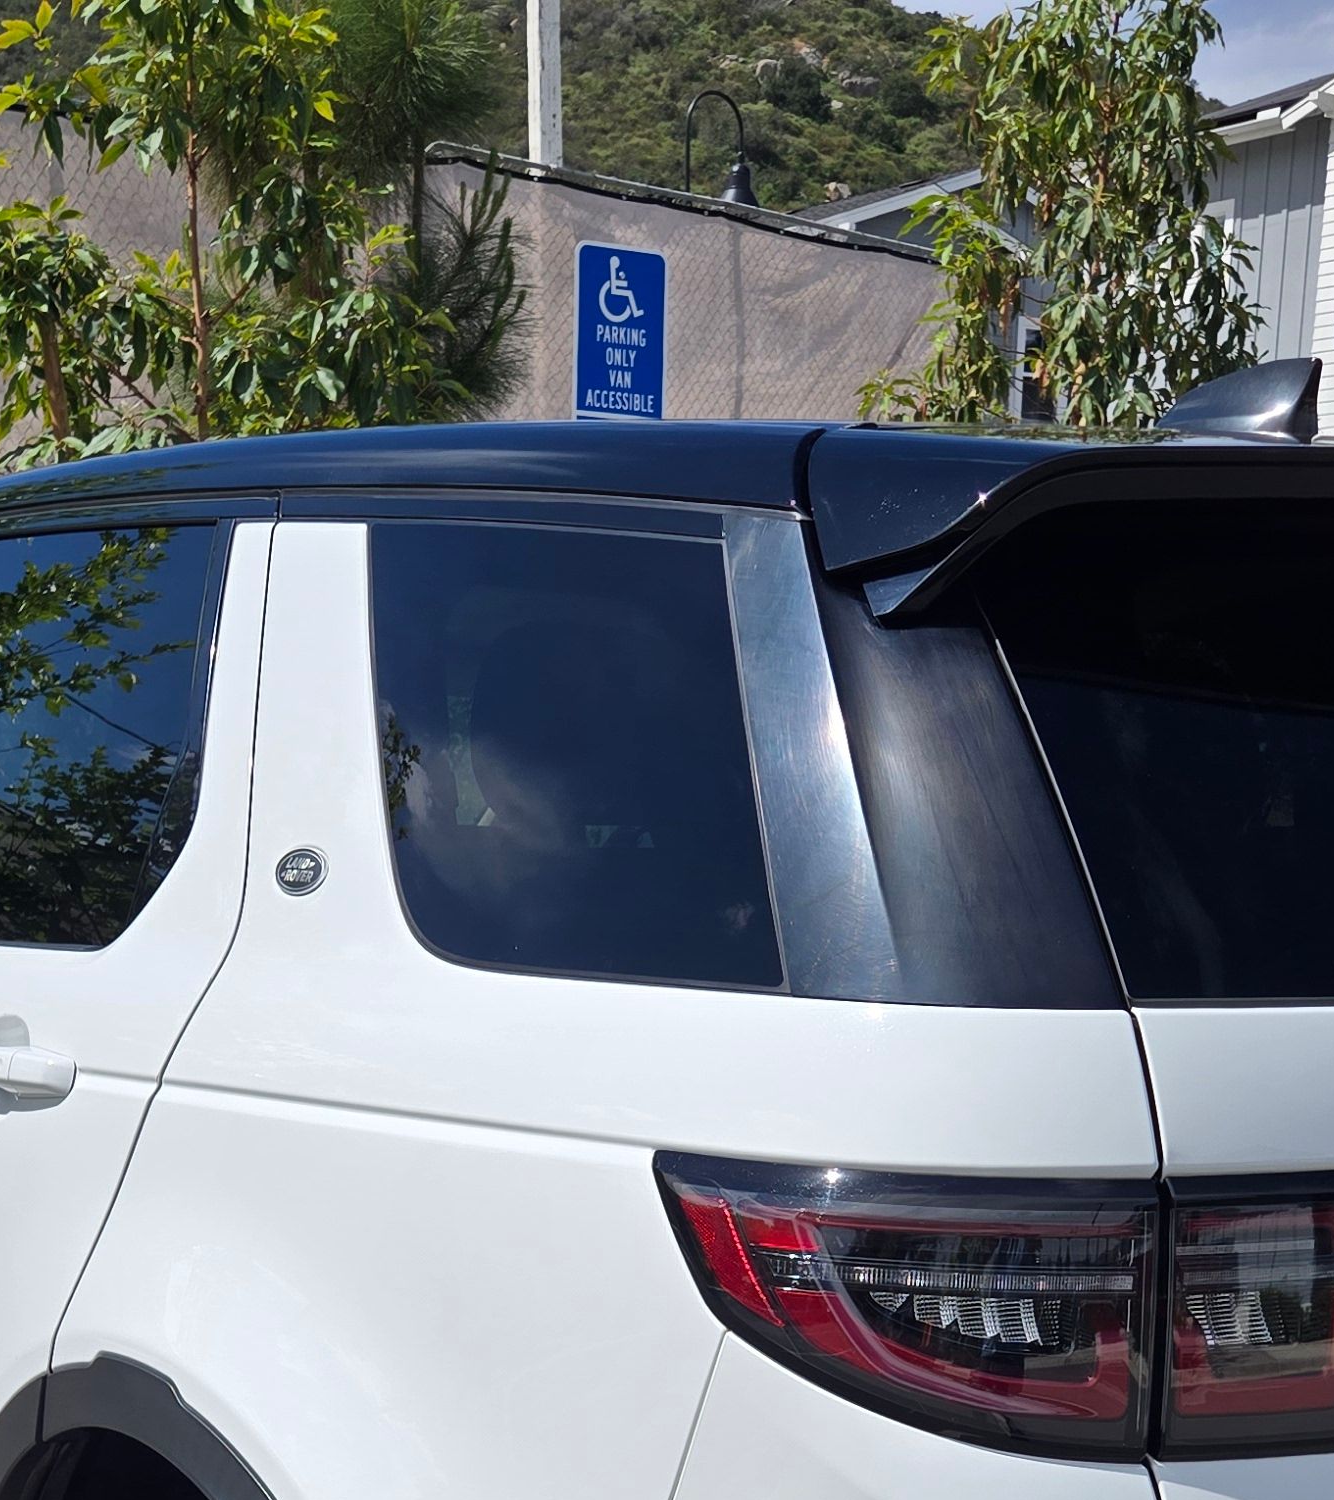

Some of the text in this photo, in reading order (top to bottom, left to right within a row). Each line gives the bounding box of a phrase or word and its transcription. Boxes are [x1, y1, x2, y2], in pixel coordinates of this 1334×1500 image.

[596, 325, 647, 347] PARKING
[606, 348, 637, 368] ONLY
[609, 369, 632, 388] VAN
[585, 389, 655, 413] ACCESSIBLE
[285, 856, 311, 870] LAND
[283, 869, 314, 883] ROVER
